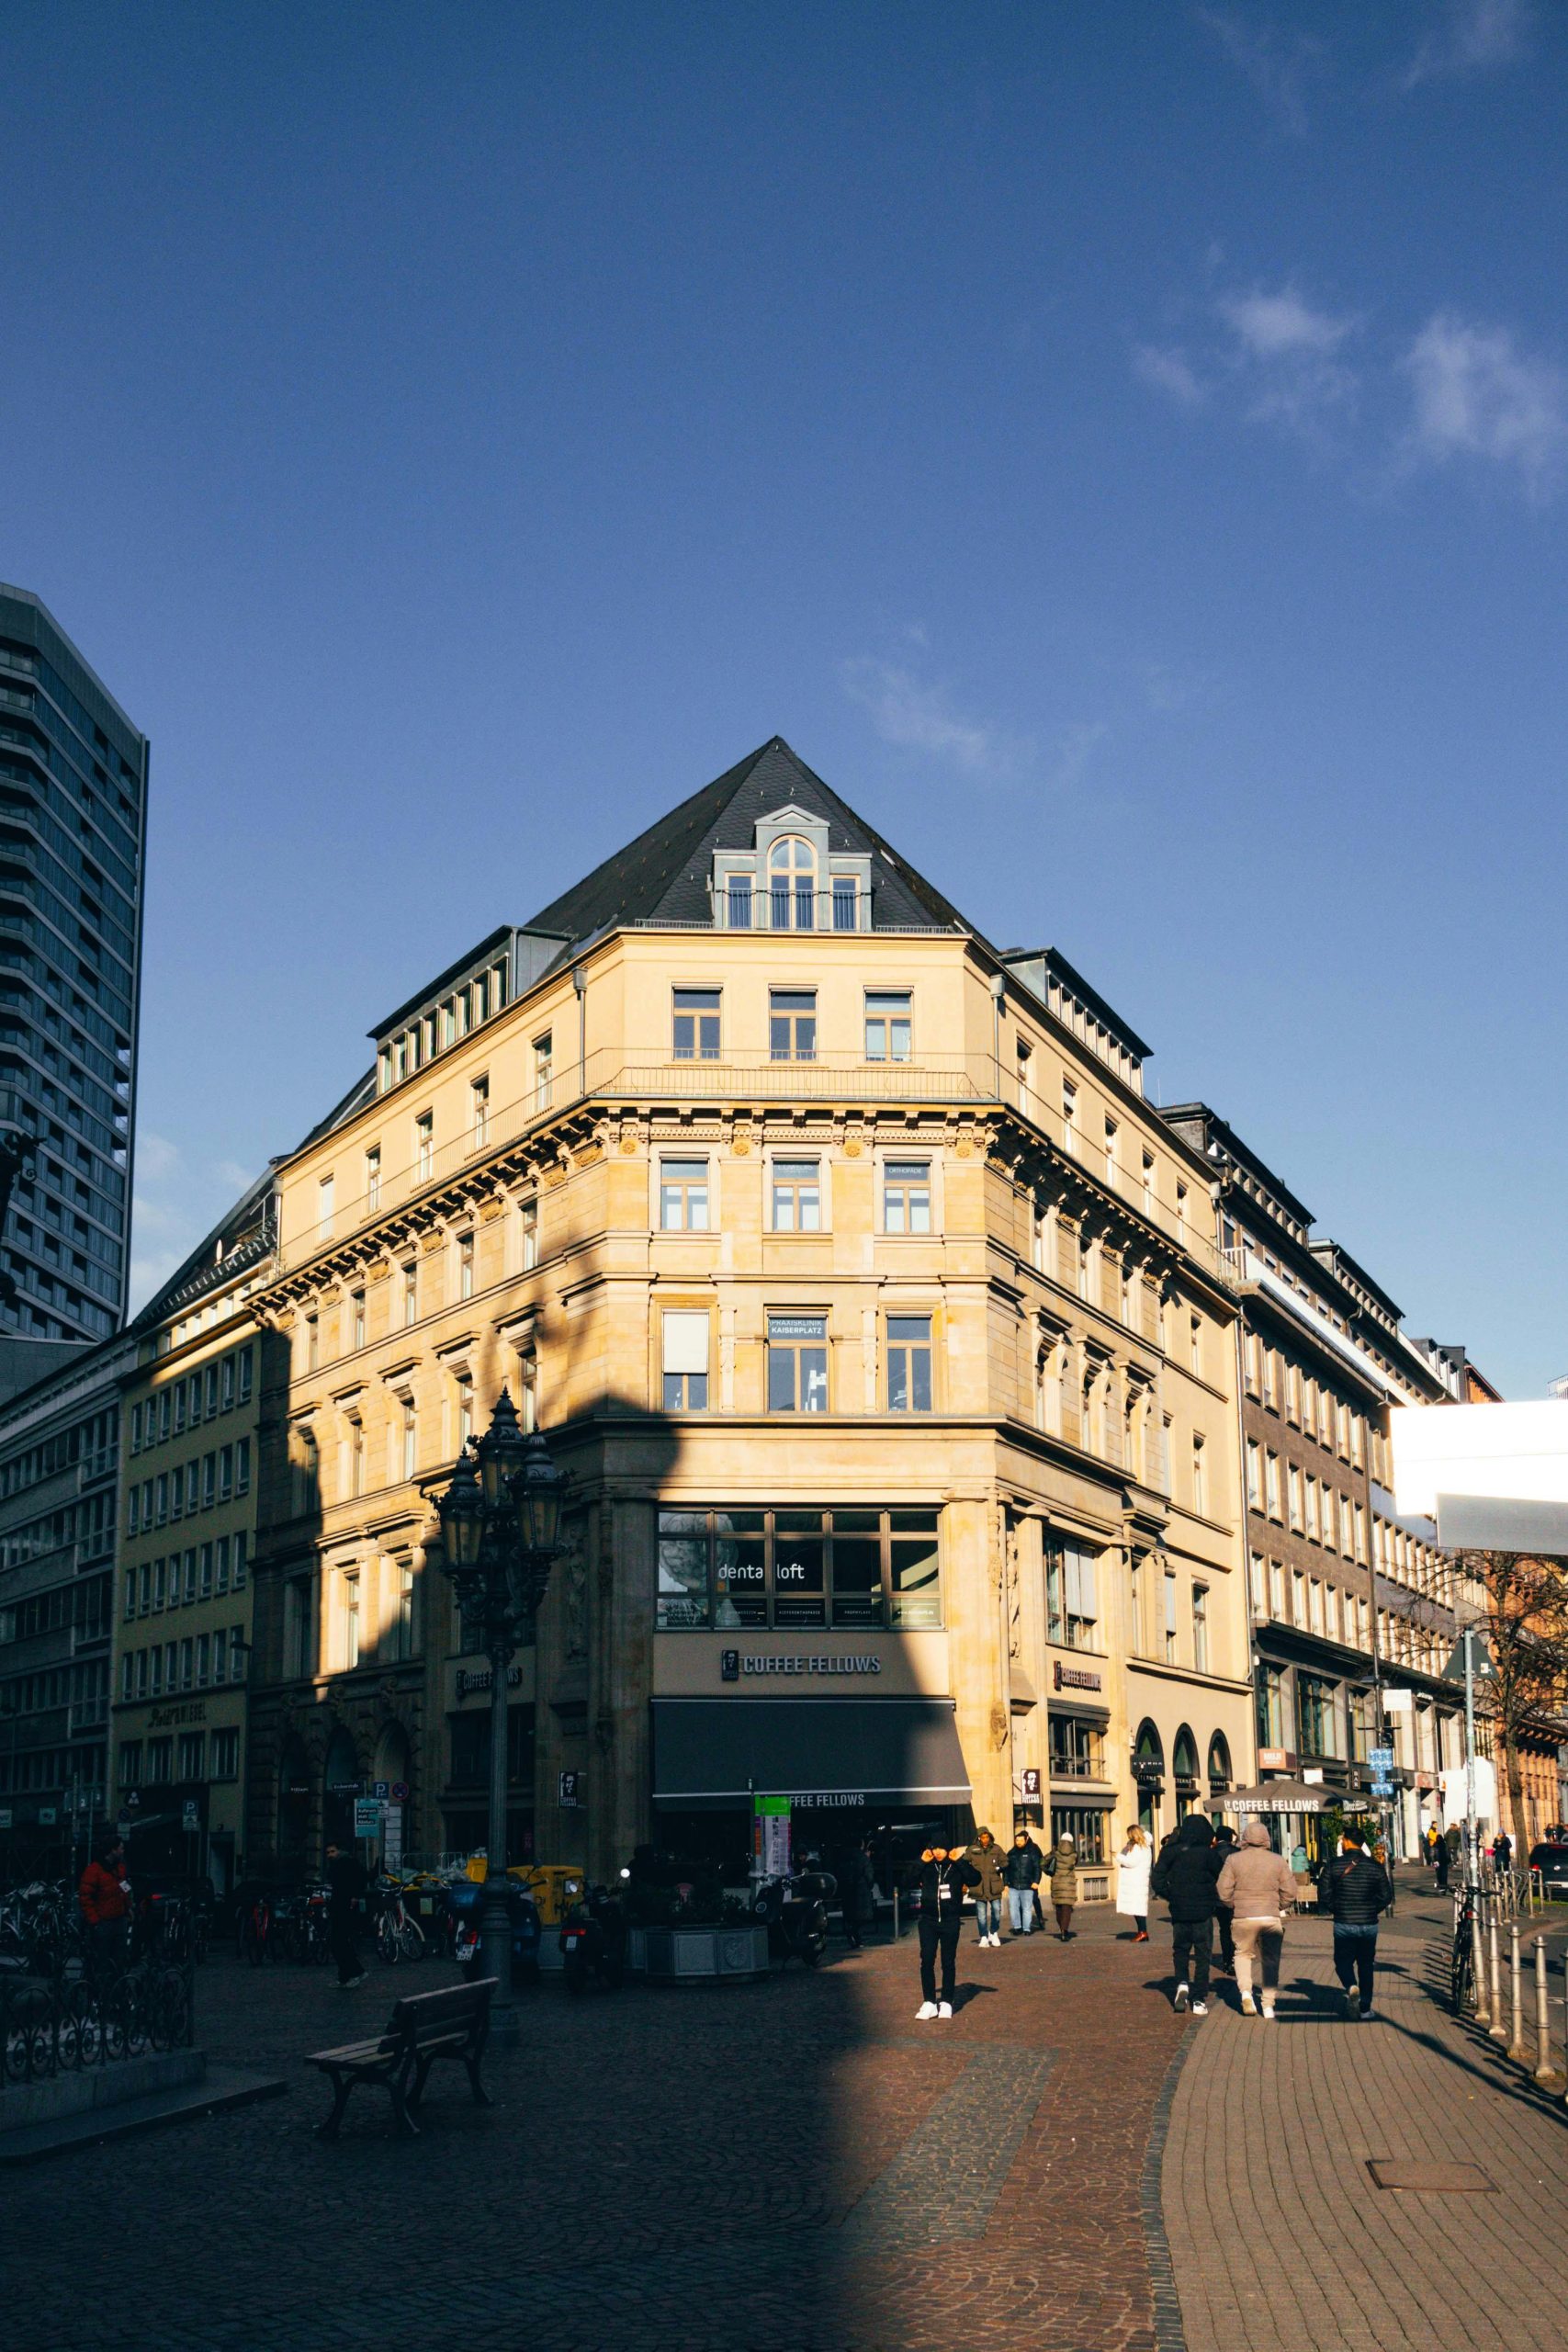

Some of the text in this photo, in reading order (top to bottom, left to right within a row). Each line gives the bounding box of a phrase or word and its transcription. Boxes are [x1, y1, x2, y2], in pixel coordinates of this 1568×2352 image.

[718, 1564, 805, 1579] denta loft
[744, 1656, 881, 1673] COFFEE FELLOWS
[464, 1671, 488, 1690] COFFEE
[1061, 1668, 1101, 1688] COFFEE FELLOWS
[377, 1783, 386, 1798] P
[817, 1794, 865, 1806] FELLOWS
[1232, 1799, 1320, 1812] COFFEE FELLOWS
